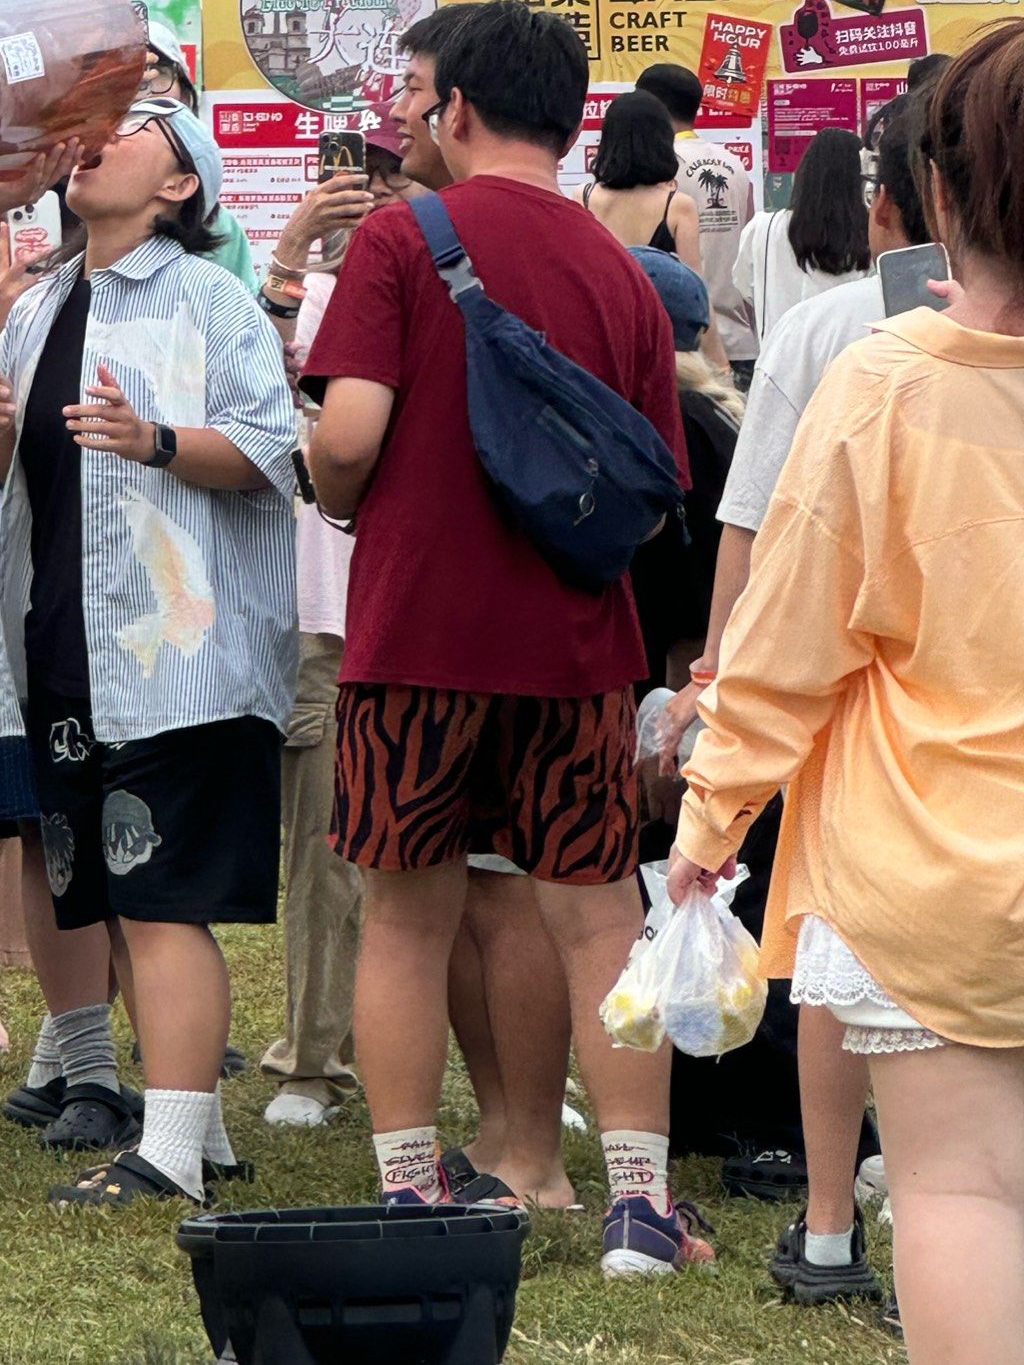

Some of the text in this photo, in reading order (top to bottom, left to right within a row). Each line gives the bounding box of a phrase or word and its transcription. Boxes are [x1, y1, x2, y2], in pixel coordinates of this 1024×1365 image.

[609, 11, 687, 29] CRAFT
[710, 19, 767, 40] HAPPY
[835, 21, 916, 44] 扫码关注抖音
[611, 35, 670, 53] BEER
[713, 33, 761, 49] HOUR
